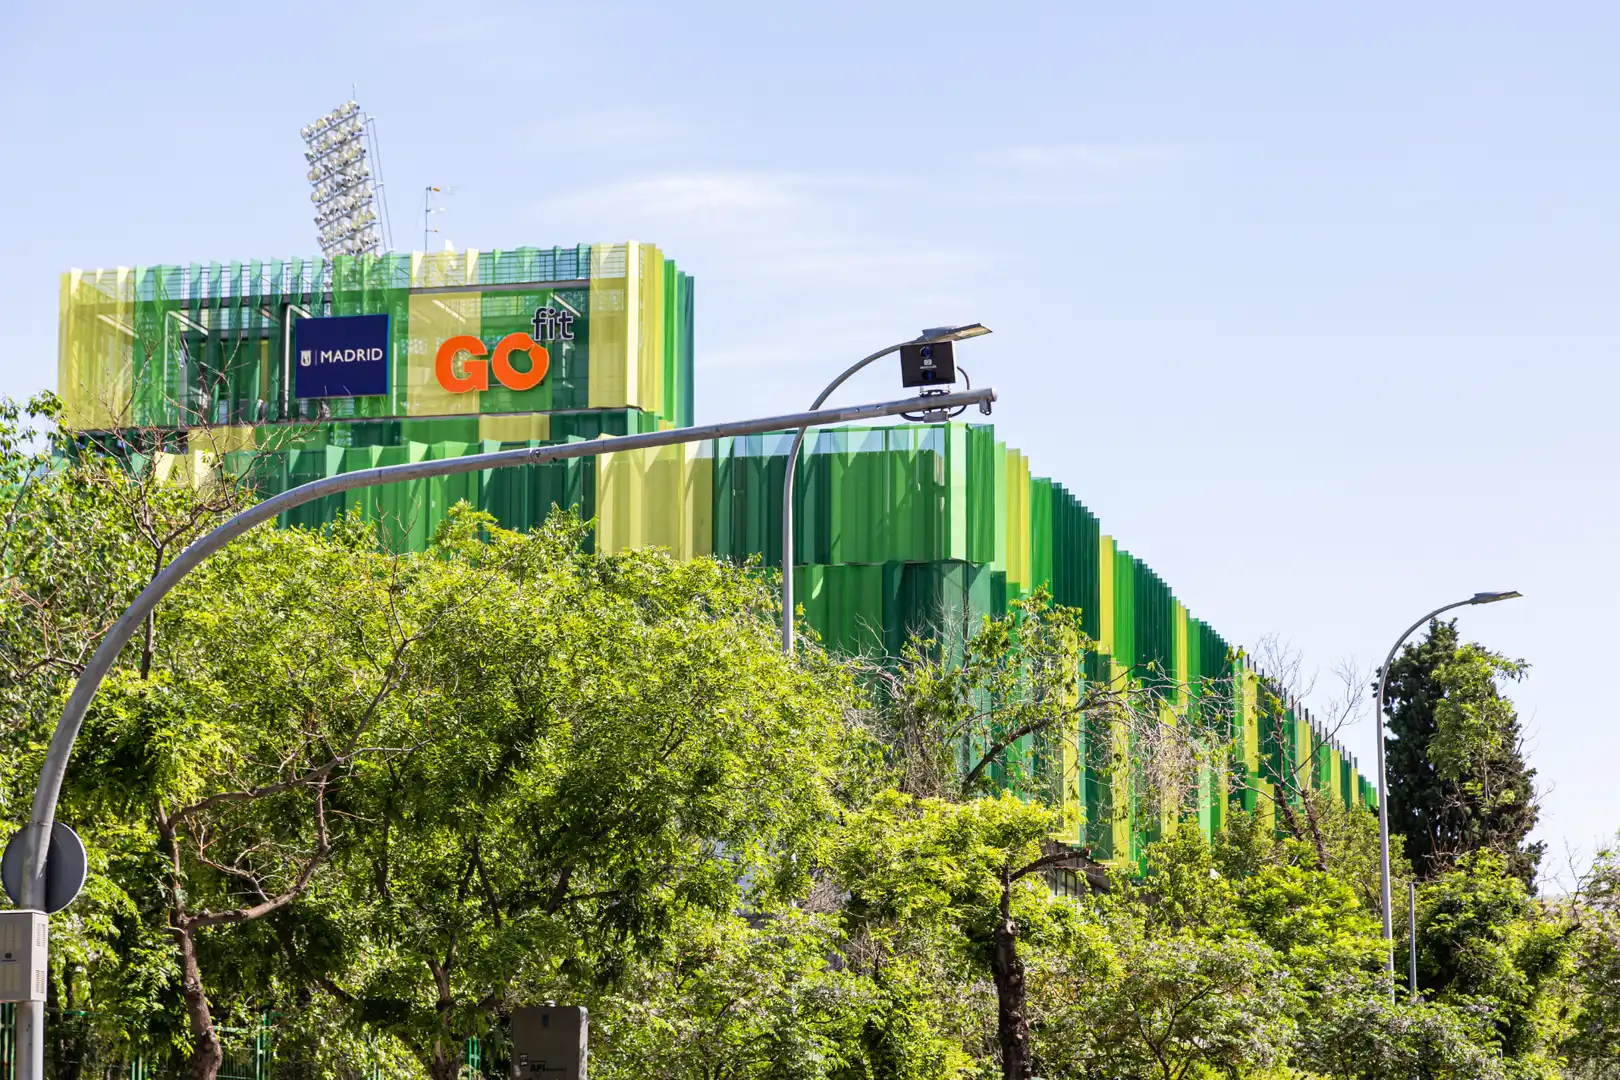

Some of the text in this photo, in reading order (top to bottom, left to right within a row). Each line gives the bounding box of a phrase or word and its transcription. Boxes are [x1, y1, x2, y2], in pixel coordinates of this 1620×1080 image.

[320, 348, 383, 364] MADRID
[435, 307, 574, 393] GO fit
